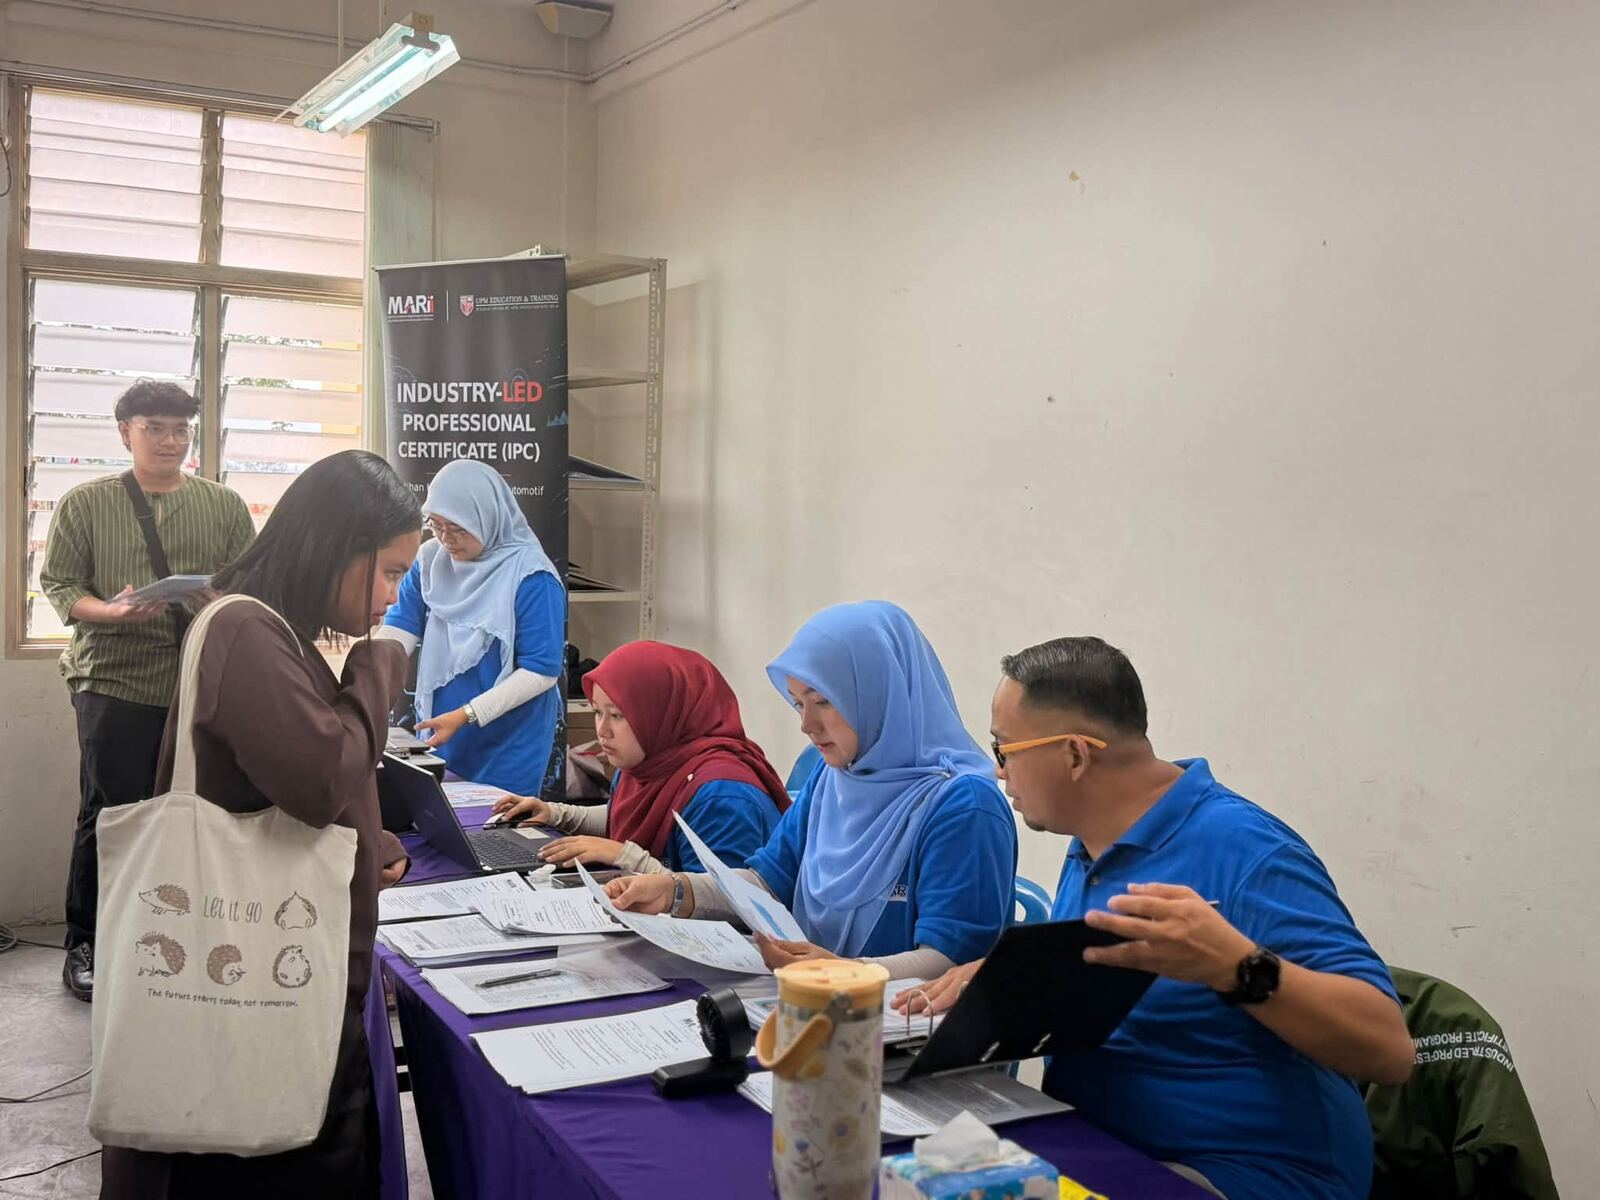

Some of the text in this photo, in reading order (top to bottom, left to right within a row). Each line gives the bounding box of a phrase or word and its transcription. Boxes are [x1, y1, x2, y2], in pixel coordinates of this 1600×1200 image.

[475, 296, 488, 304] UPM
[490, 295, 523, 304] EDUCATION
[530, 294, 559, 302] TRAINING
[396, 381, 543, 404] INDUSTRY-LED
[402, 413, 536, 432] PROFESSIONAL
[398, 441, 541, 463] CERTIFICATE (IPC)
[229, 900, 240, 921] it
[245, 901, 263, 923] go
[147, 987, 162, 997] The
[165, 990, 191, 1000] future
[193, 994, 217, 1005] starts
[243, 999, 256, 1007] not
